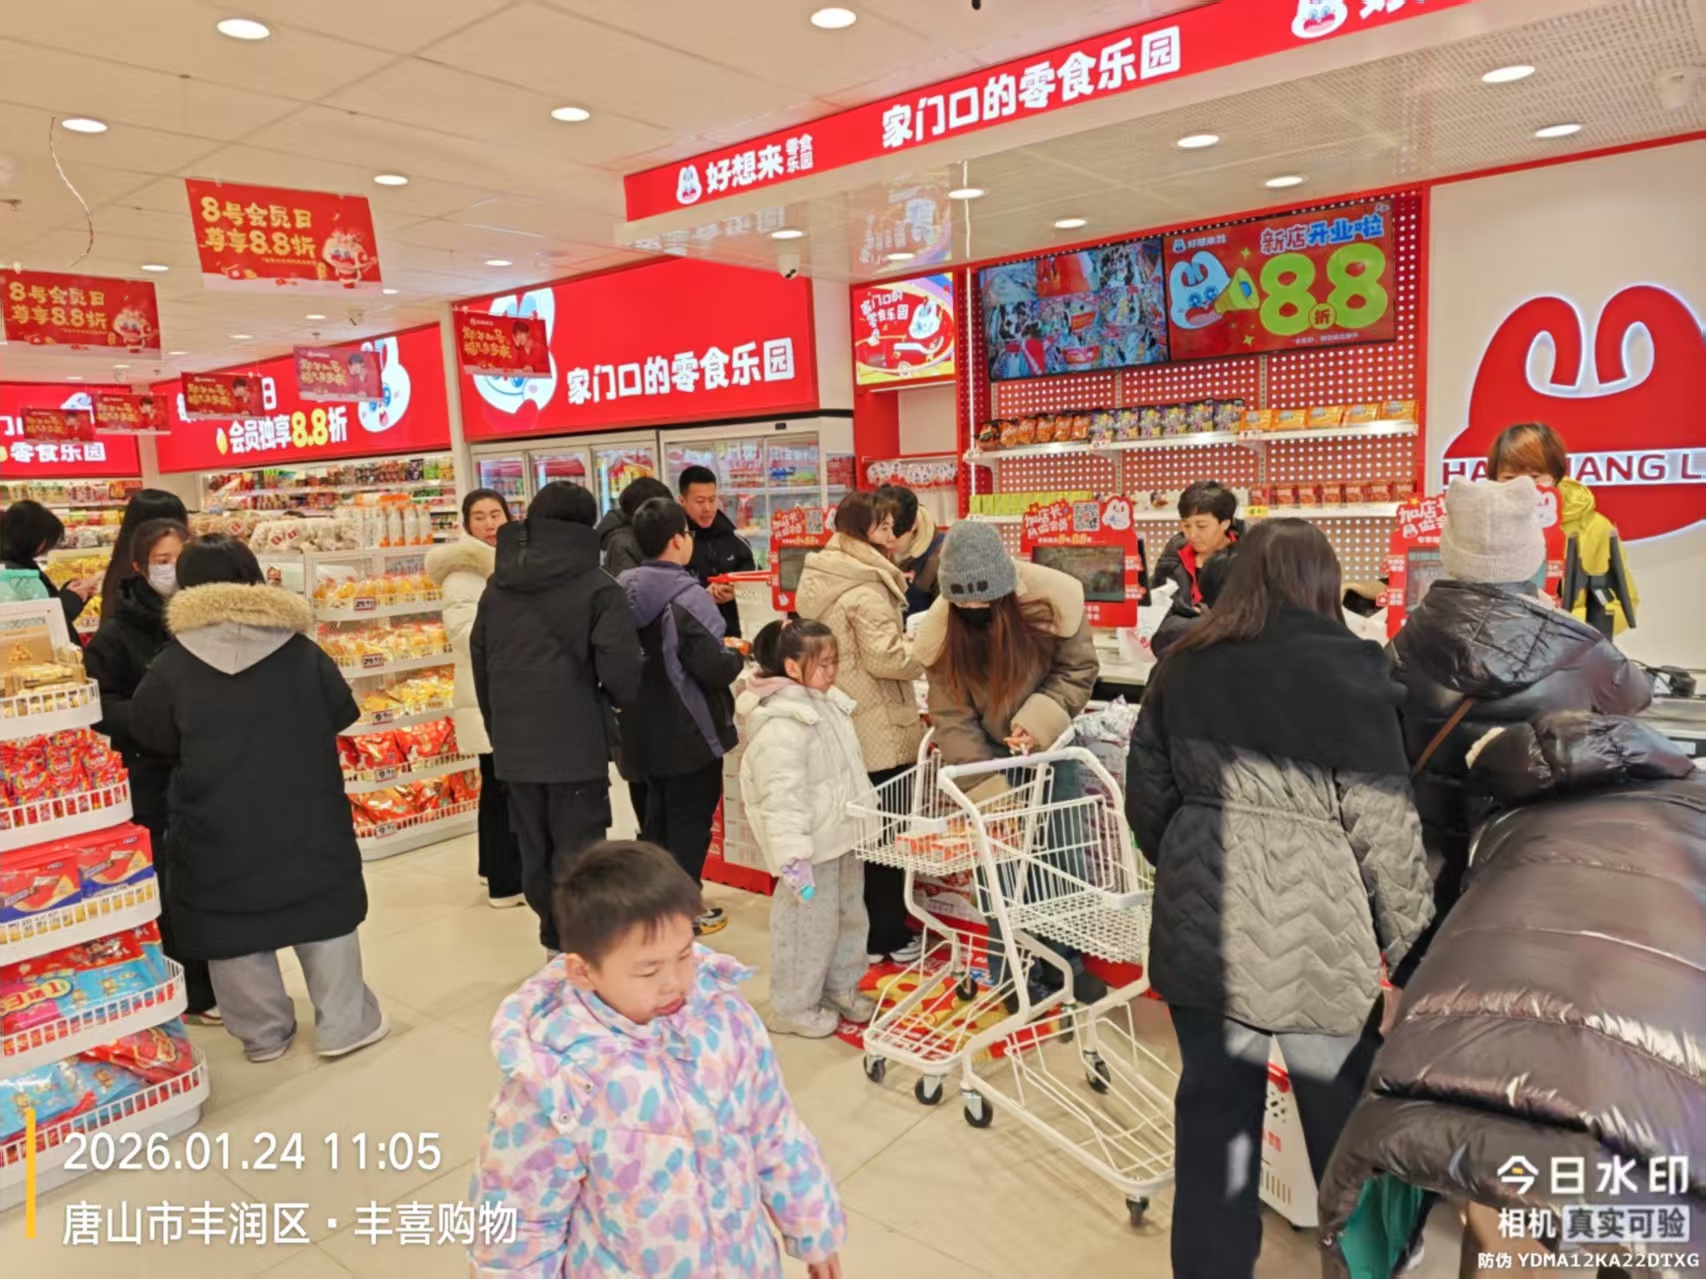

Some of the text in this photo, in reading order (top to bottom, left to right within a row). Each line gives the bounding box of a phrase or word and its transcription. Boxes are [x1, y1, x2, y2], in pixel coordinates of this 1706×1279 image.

[881, 26, 1181, 149] 家门口的零食乐园
[706, 144, 784, 194] 好想来
[201, 196, 312, 229] 8号会员日
[205, 227, 316, 259] 尊享8.8折
[1260, 214, 1384, 254] 新店开业啦
[9, 281, 105, 307] 8号会员日
[12, 304, 108, 330] 尊享8.8折
[1313, 307, 1331, 326] 折
[567, 337, 796, 406] 家门口的零食乐园
[228, 405, 349, 454] 会员独享8.8折
[10, 441, 107, 464] 零食乐园
